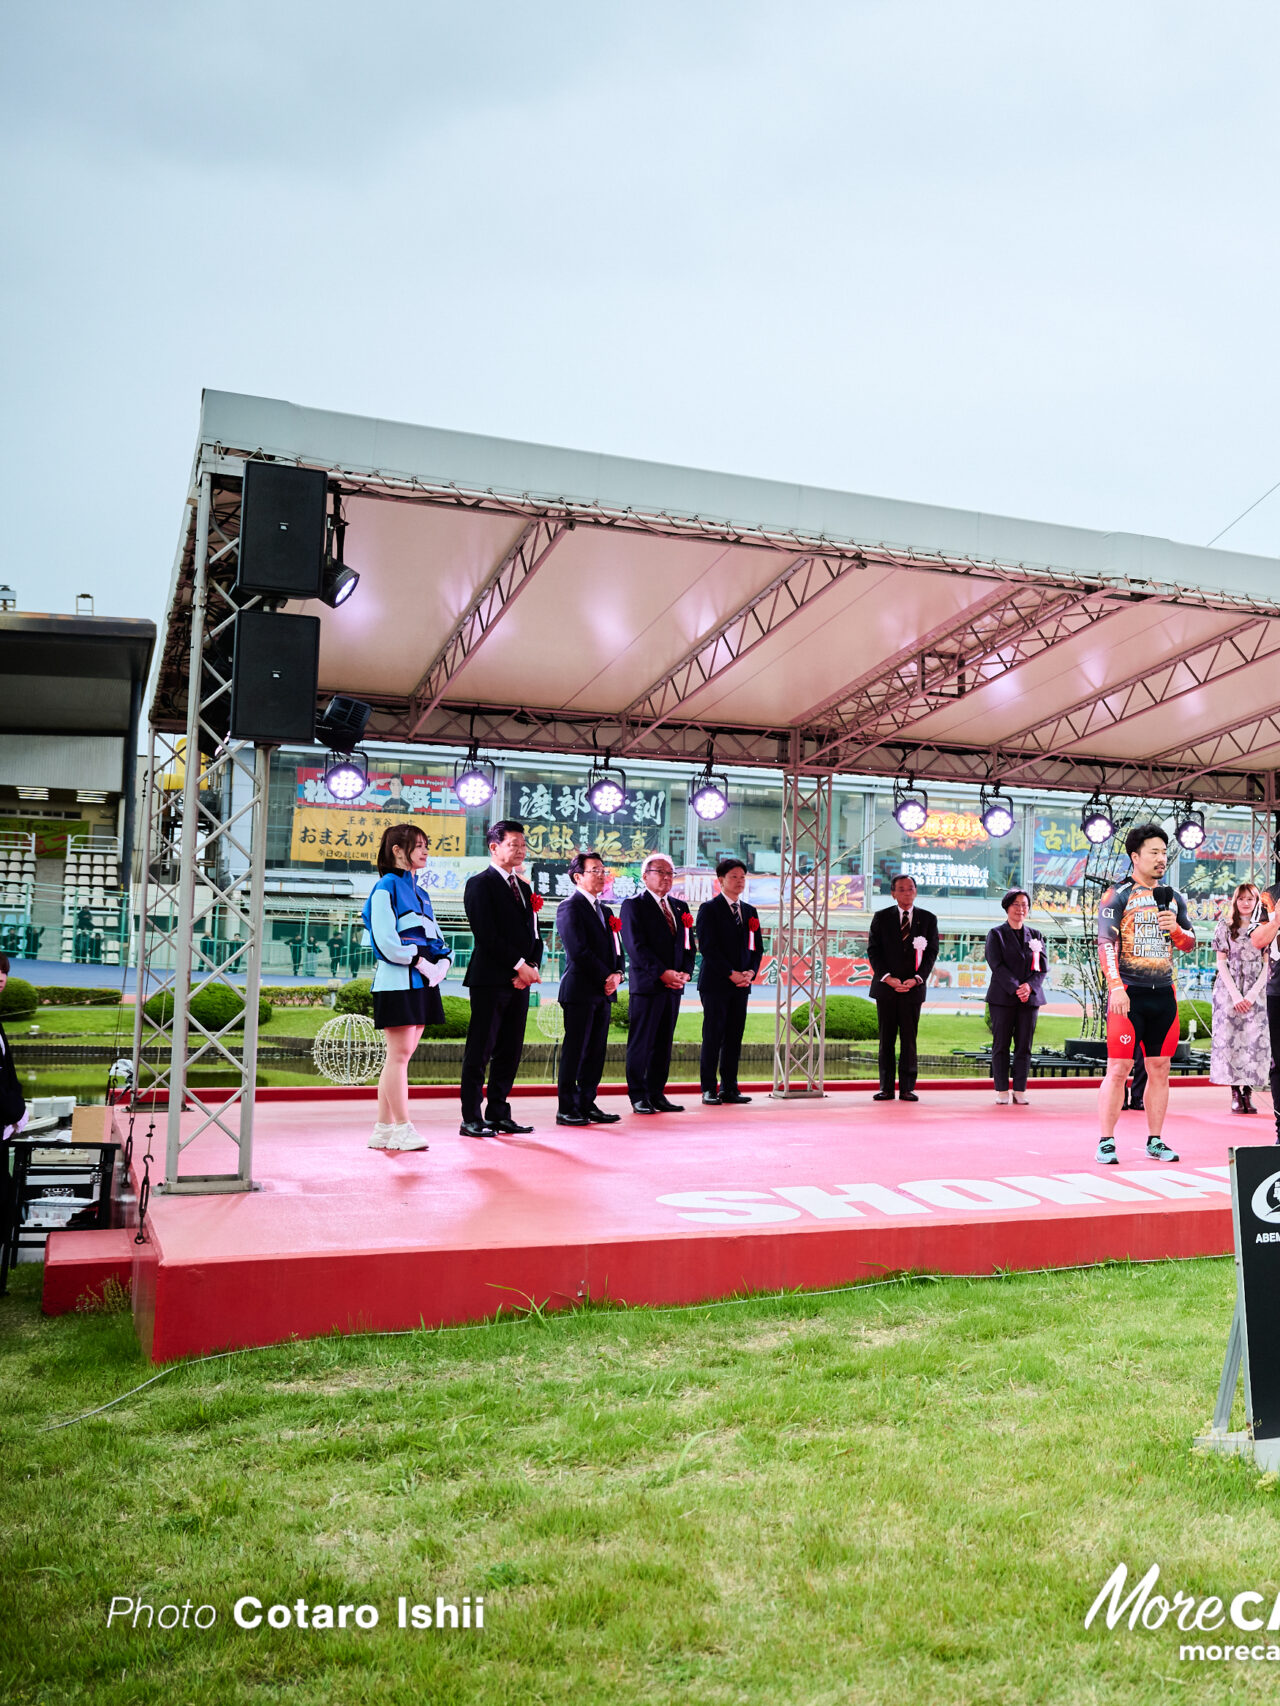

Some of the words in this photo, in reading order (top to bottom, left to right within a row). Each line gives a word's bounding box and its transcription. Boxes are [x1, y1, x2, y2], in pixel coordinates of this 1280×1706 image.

[518, 783, 666, 825] 渡部訓
[925, 876, 989, 888] HIRATSUKA
[1102, 907, 1115, 919] GI
